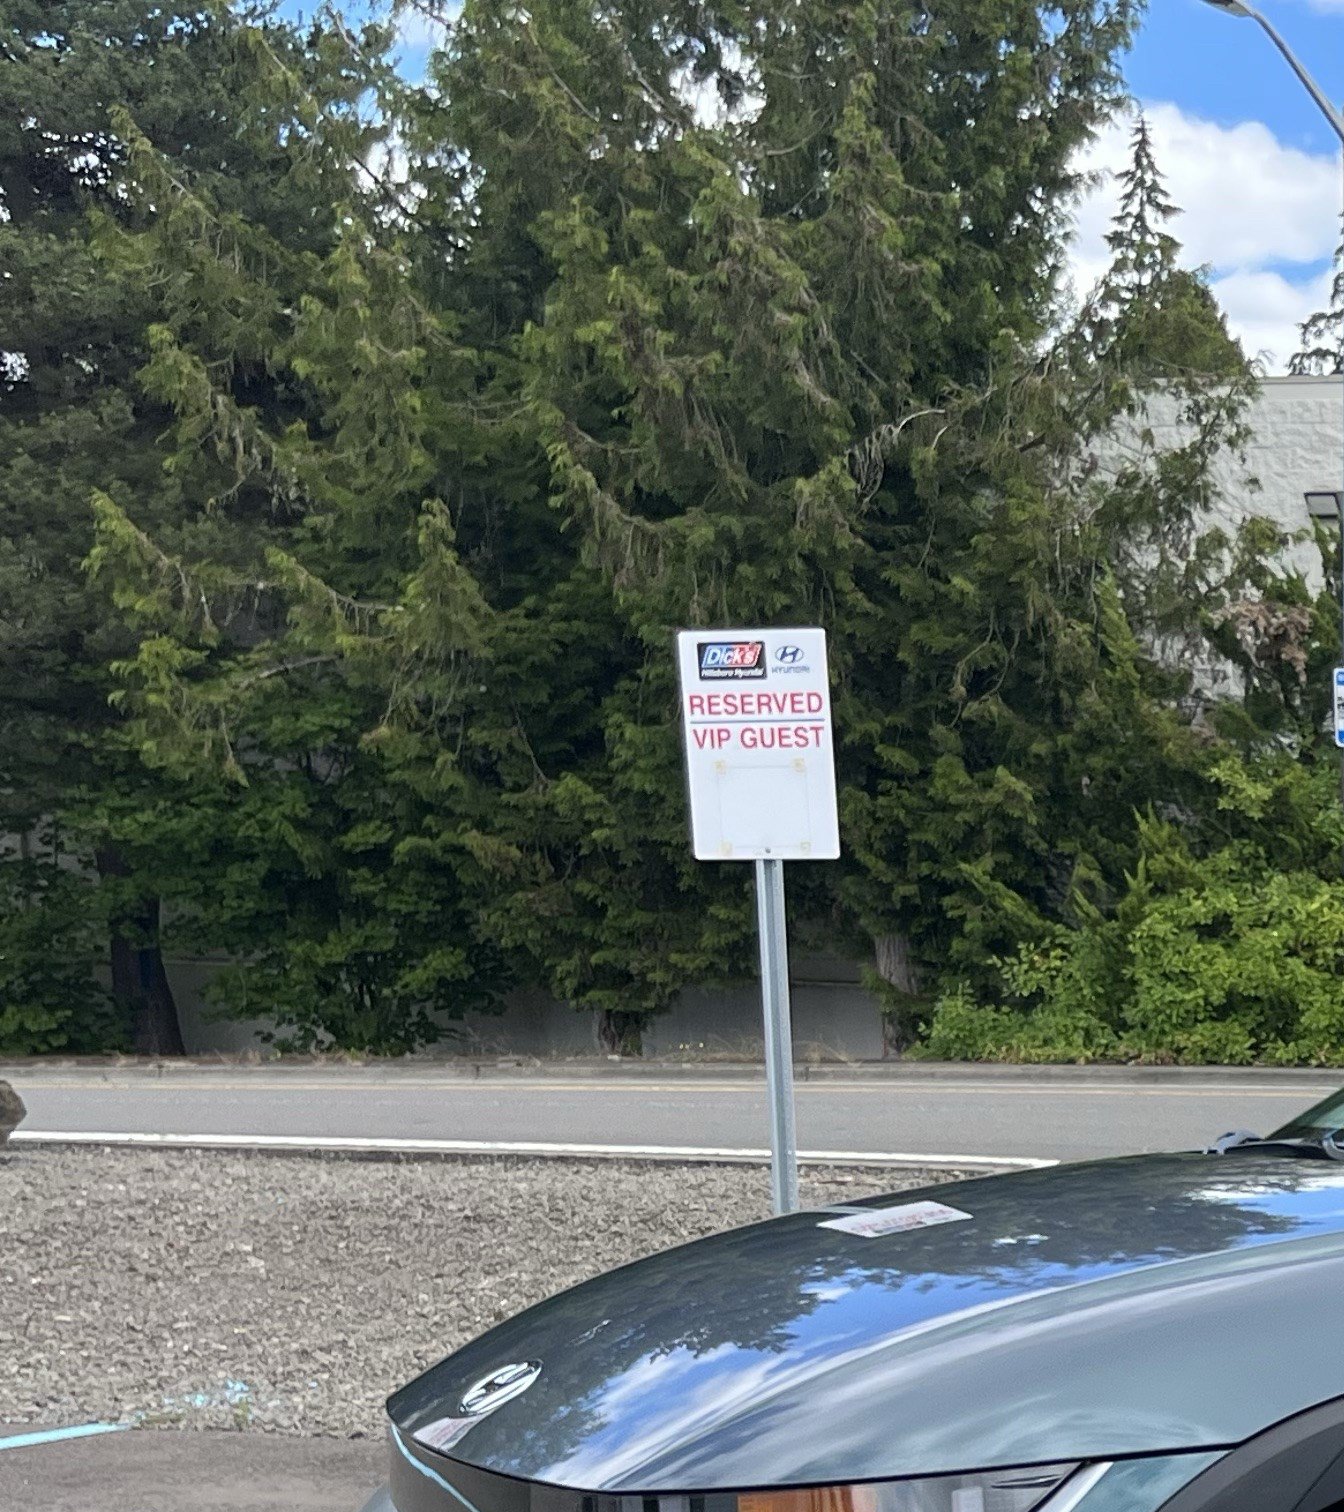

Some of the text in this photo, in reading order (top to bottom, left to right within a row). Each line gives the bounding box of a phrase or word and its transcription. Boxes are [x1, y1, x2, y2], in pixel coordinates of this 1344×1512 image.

[689, 691, 823, 716] RESERVED
[693, 726, 825, 750] VIP GUEST
